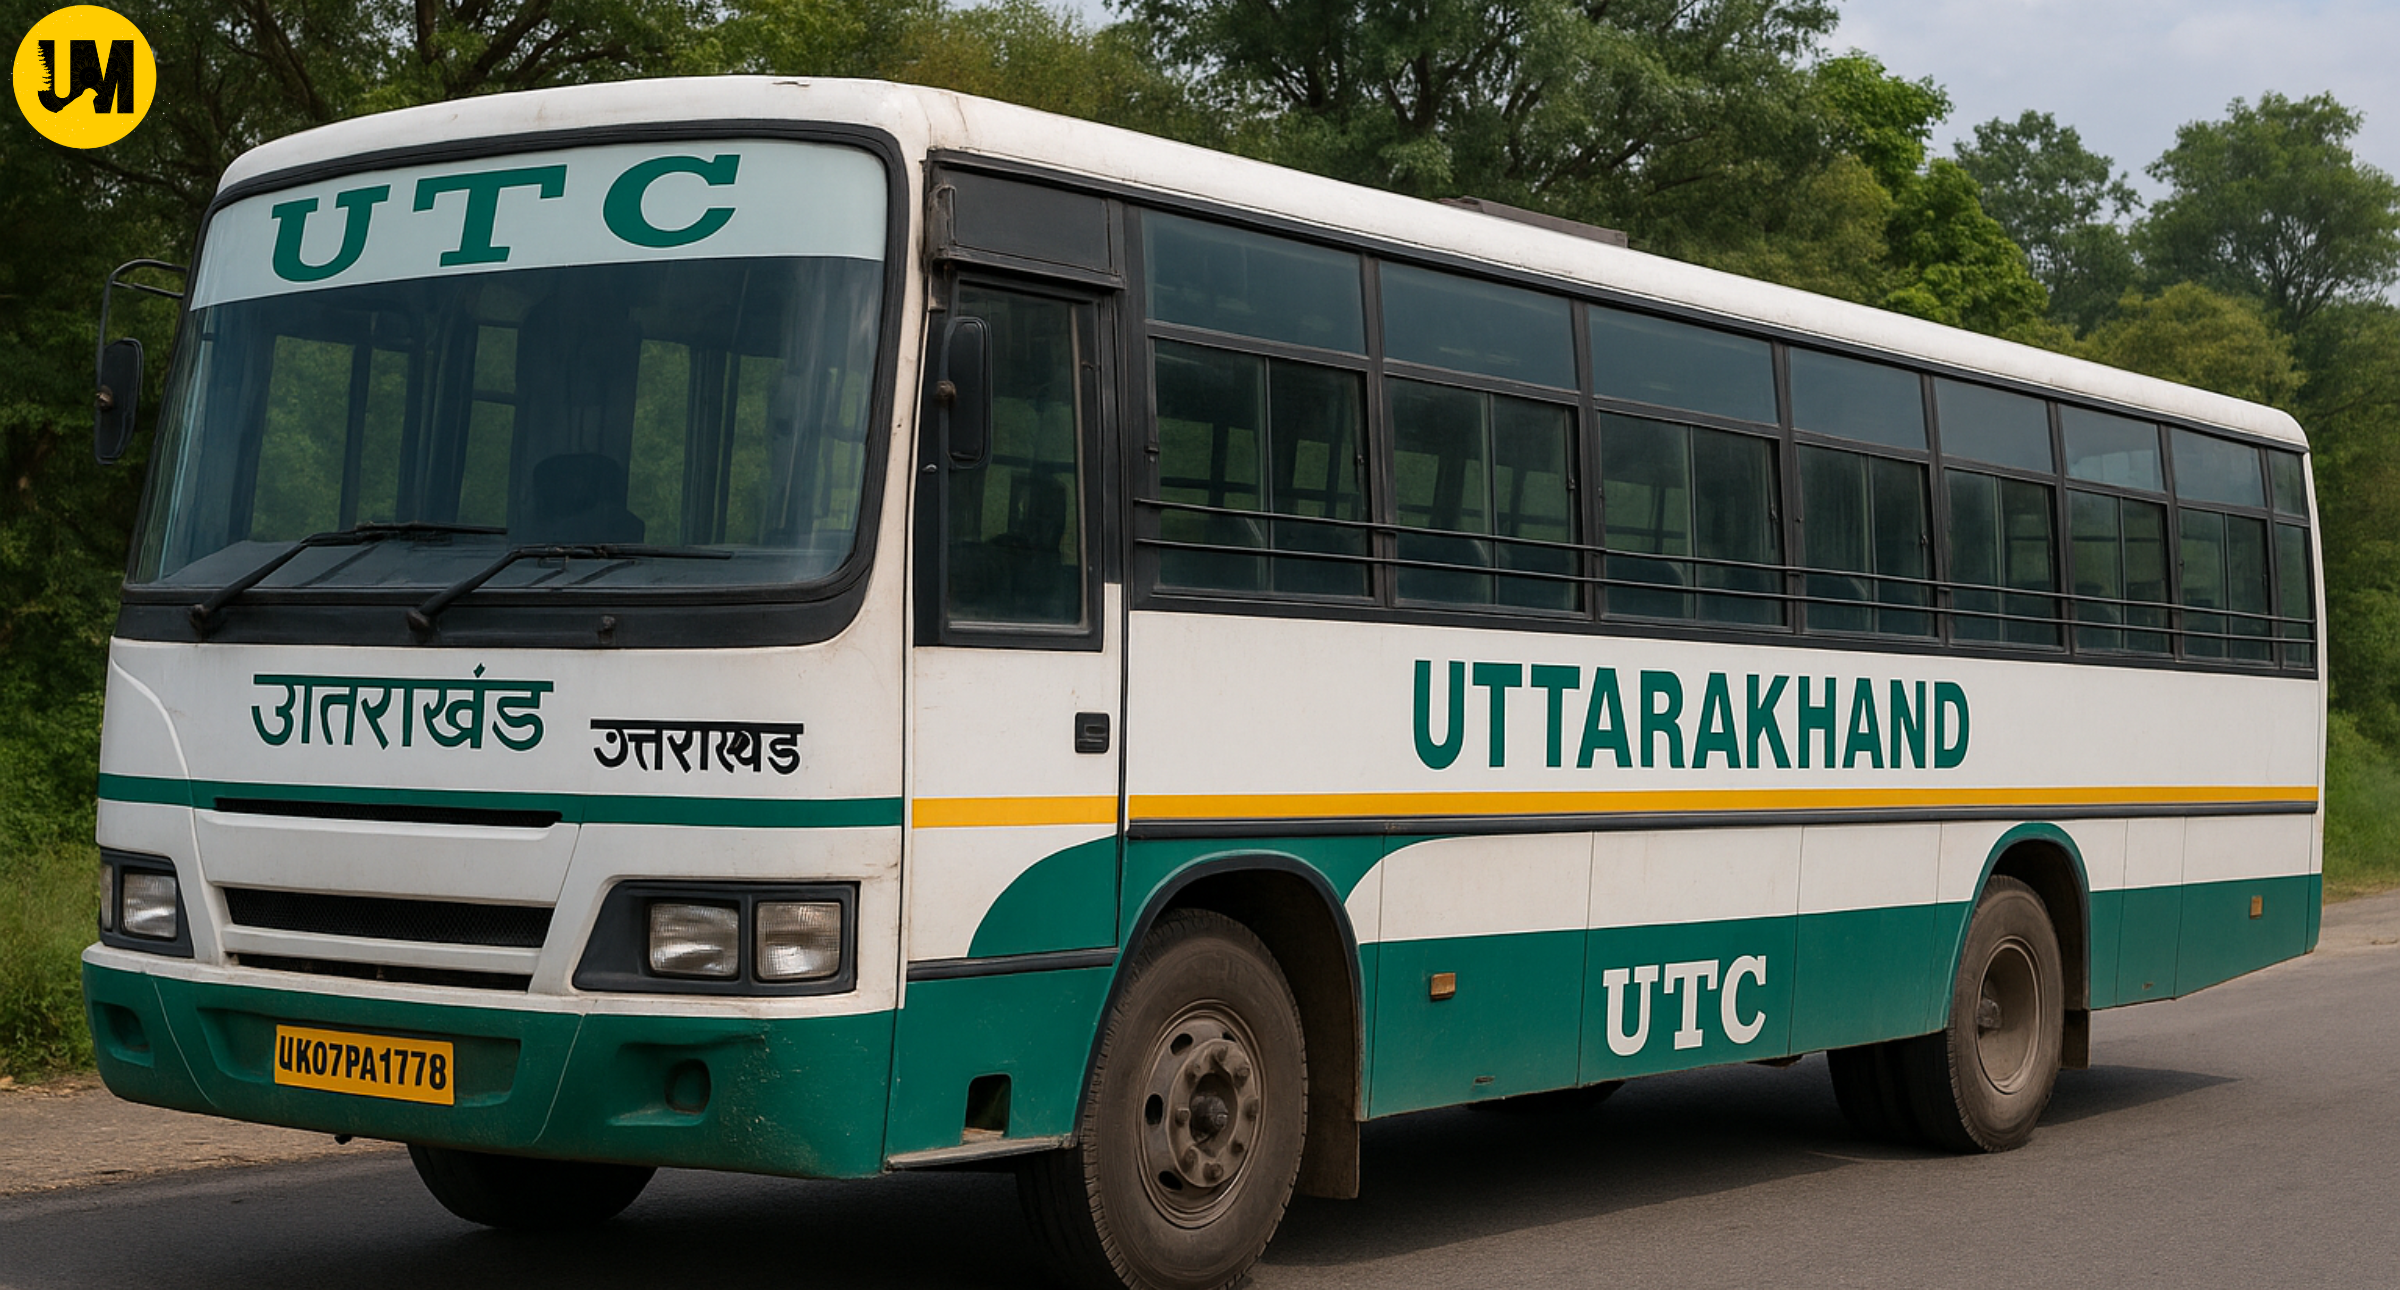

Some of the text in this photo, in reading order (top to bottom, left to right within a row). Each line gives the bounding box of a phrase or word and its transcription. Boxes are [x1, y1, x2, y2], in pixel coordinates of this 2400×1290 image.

[270, 153, 742, 284] UTC
[1413, 659, 1971, 771] UTTARAKHAND
[1602, 955, 1768, 1056] UTC
[278, 1034, 447, 1091] UK07PA1778
